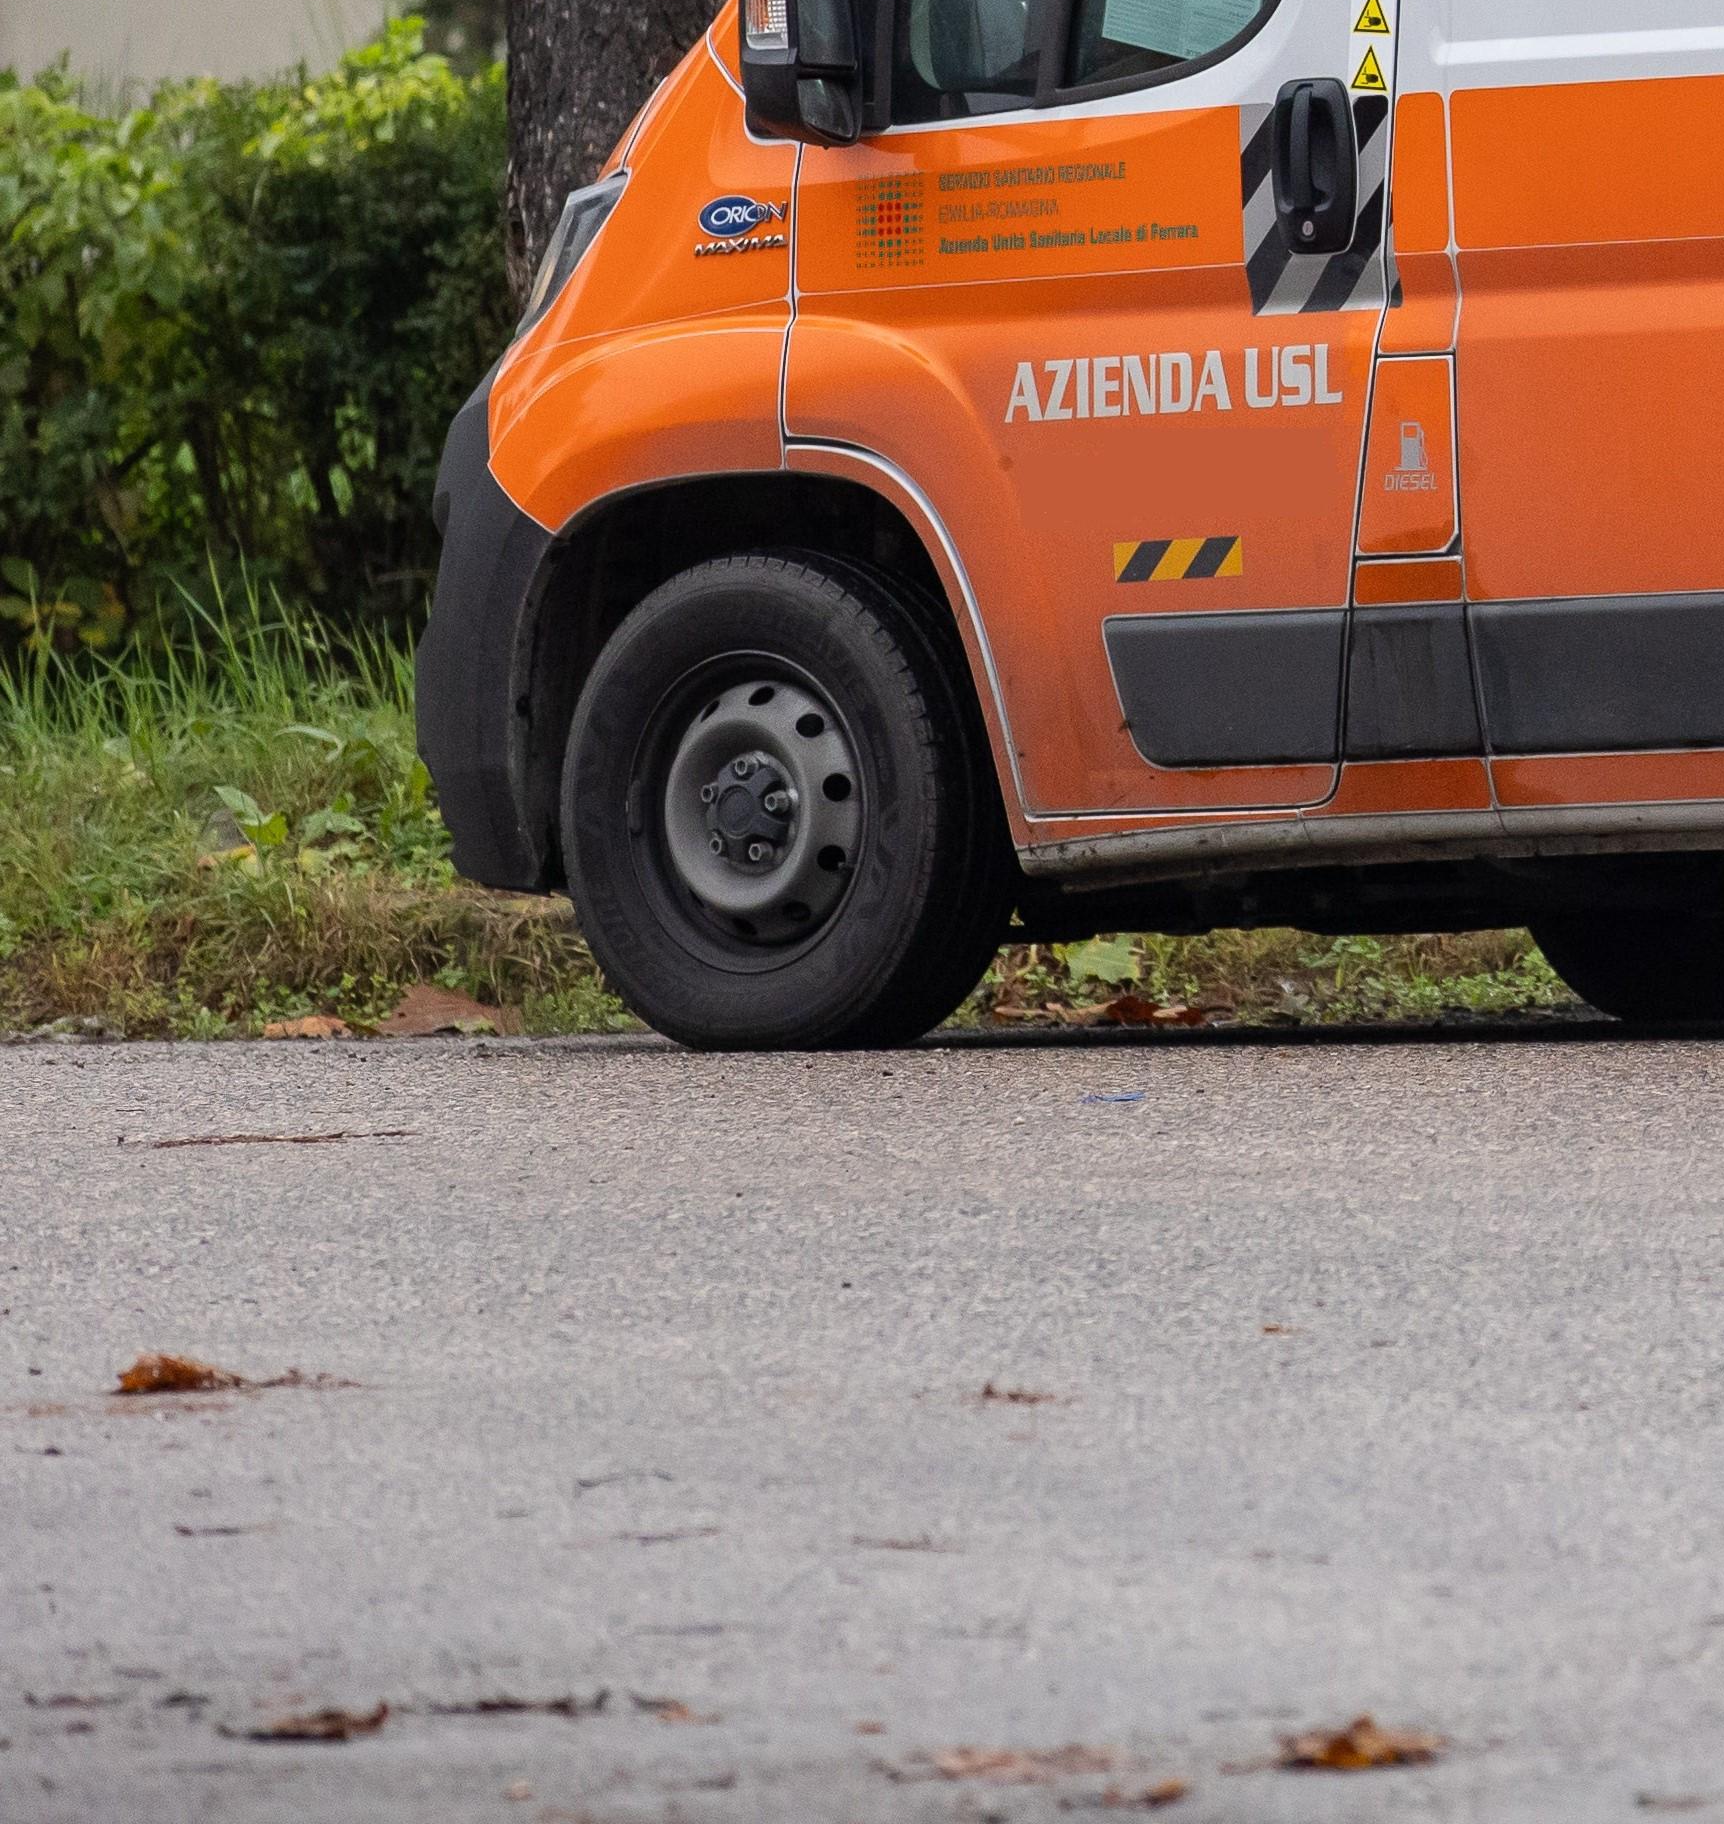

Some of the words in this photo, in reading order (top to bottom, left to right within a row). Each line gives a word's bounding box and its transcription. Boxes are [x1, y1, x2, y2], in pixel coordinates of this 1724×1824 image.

[1058, 160, 1127, 184] REGIONALE
[710, 200, 789, 226] ORION
[694, 233, 788, 258] MAXIMA
[1090, 226, 1133, 245] Locale
[1150, 222, 1200, 240] Ferrara
[1004, 348, 1232, 424] AZIENDA
[1243, 342, 1343, 410] USL
[1383, 471, 1439, 492] DIESEL
